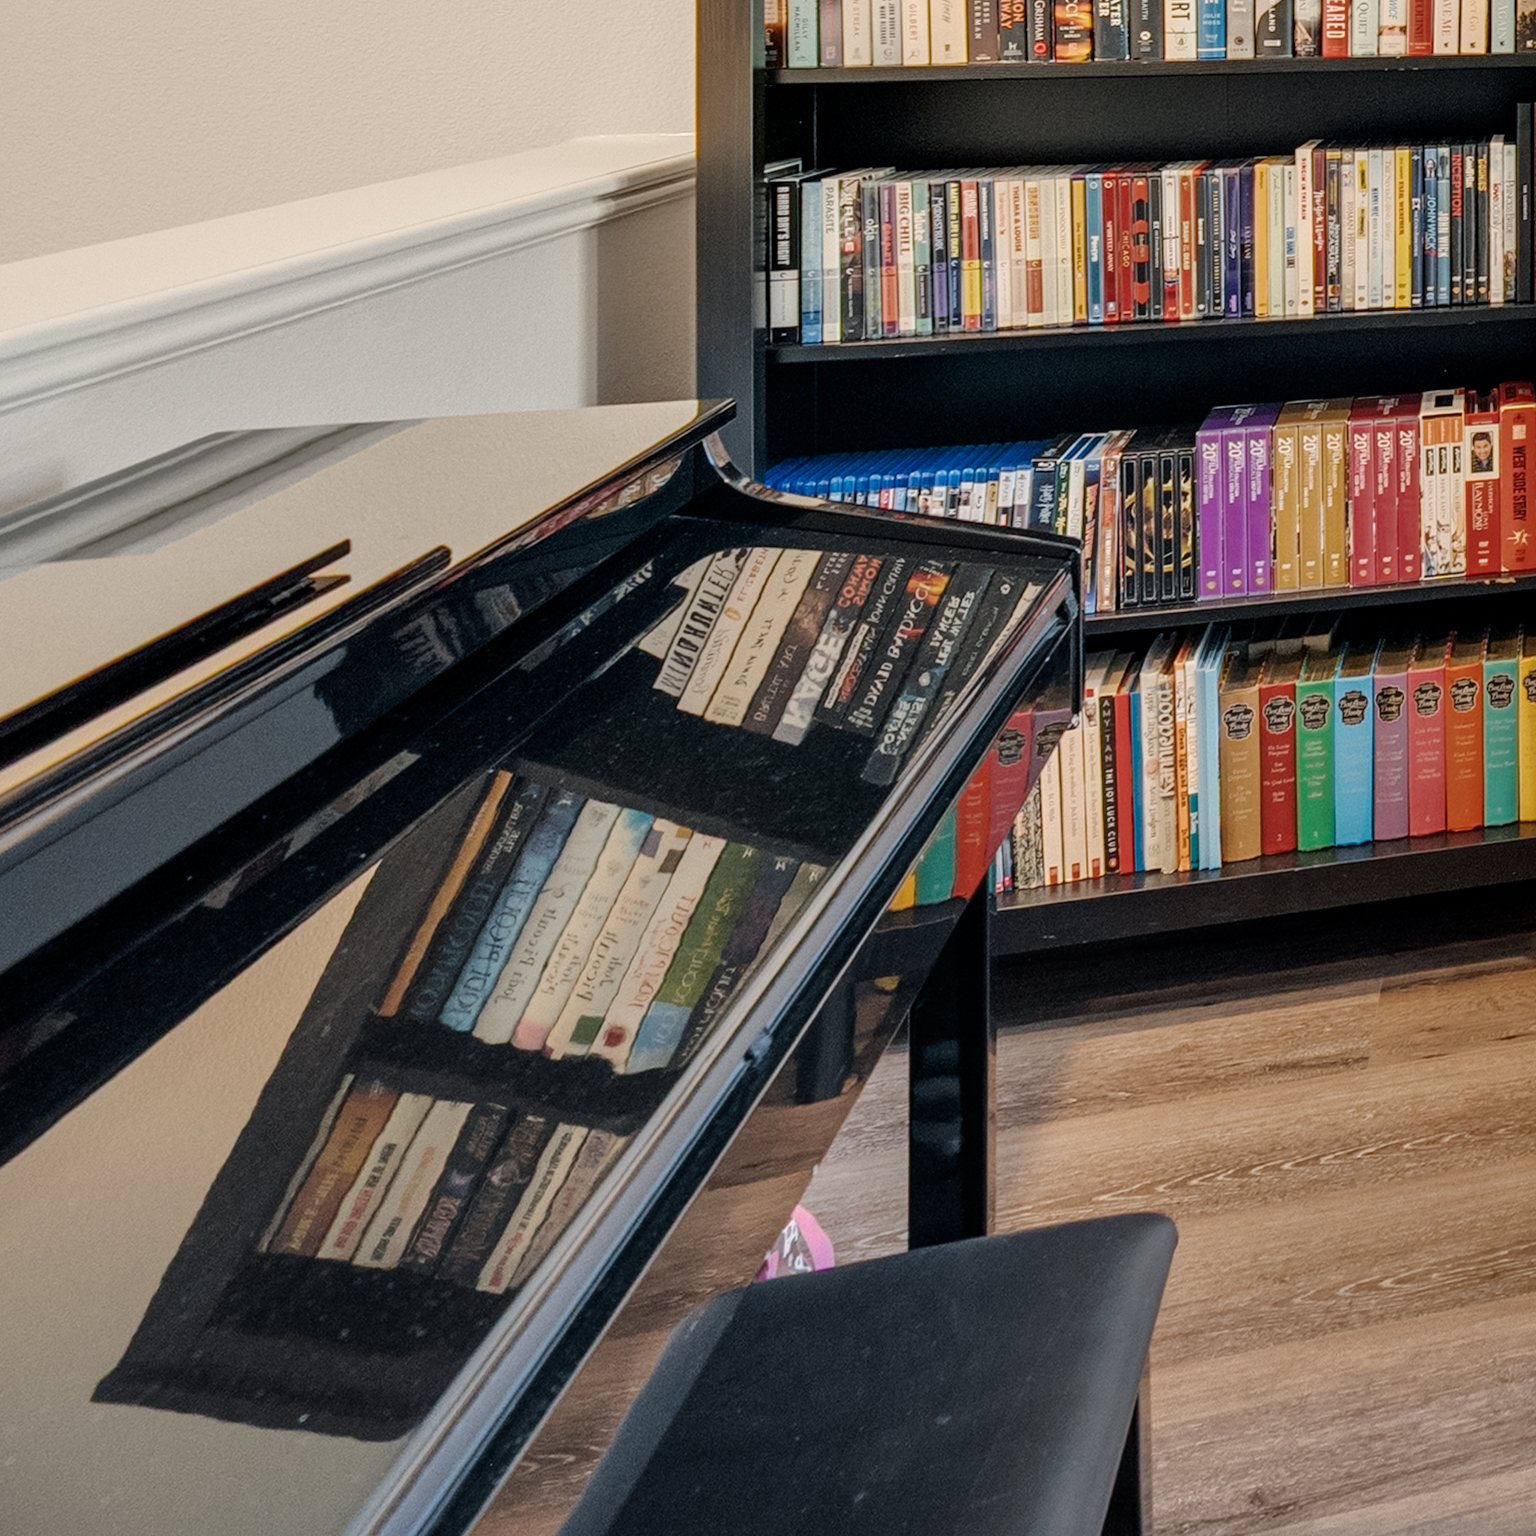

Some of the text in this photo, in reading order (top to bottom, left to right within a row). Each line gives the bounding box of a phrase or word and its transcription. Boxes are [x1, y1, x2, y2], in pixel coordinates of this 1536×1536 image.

[908, 4, 918, 41] GILBERT
[825, 187, 834, 234] PARASITE
[1452, 154, 1463, 218] INCEPTION
[899, 190, 910, 255] BIG CHILL
[1425, 194, 1437, 251] JOHN WICK
[1513, 446, 1526, 522] WEST SIDE STORY
[1107, 807, 1116, 853] LUCK CLUB
